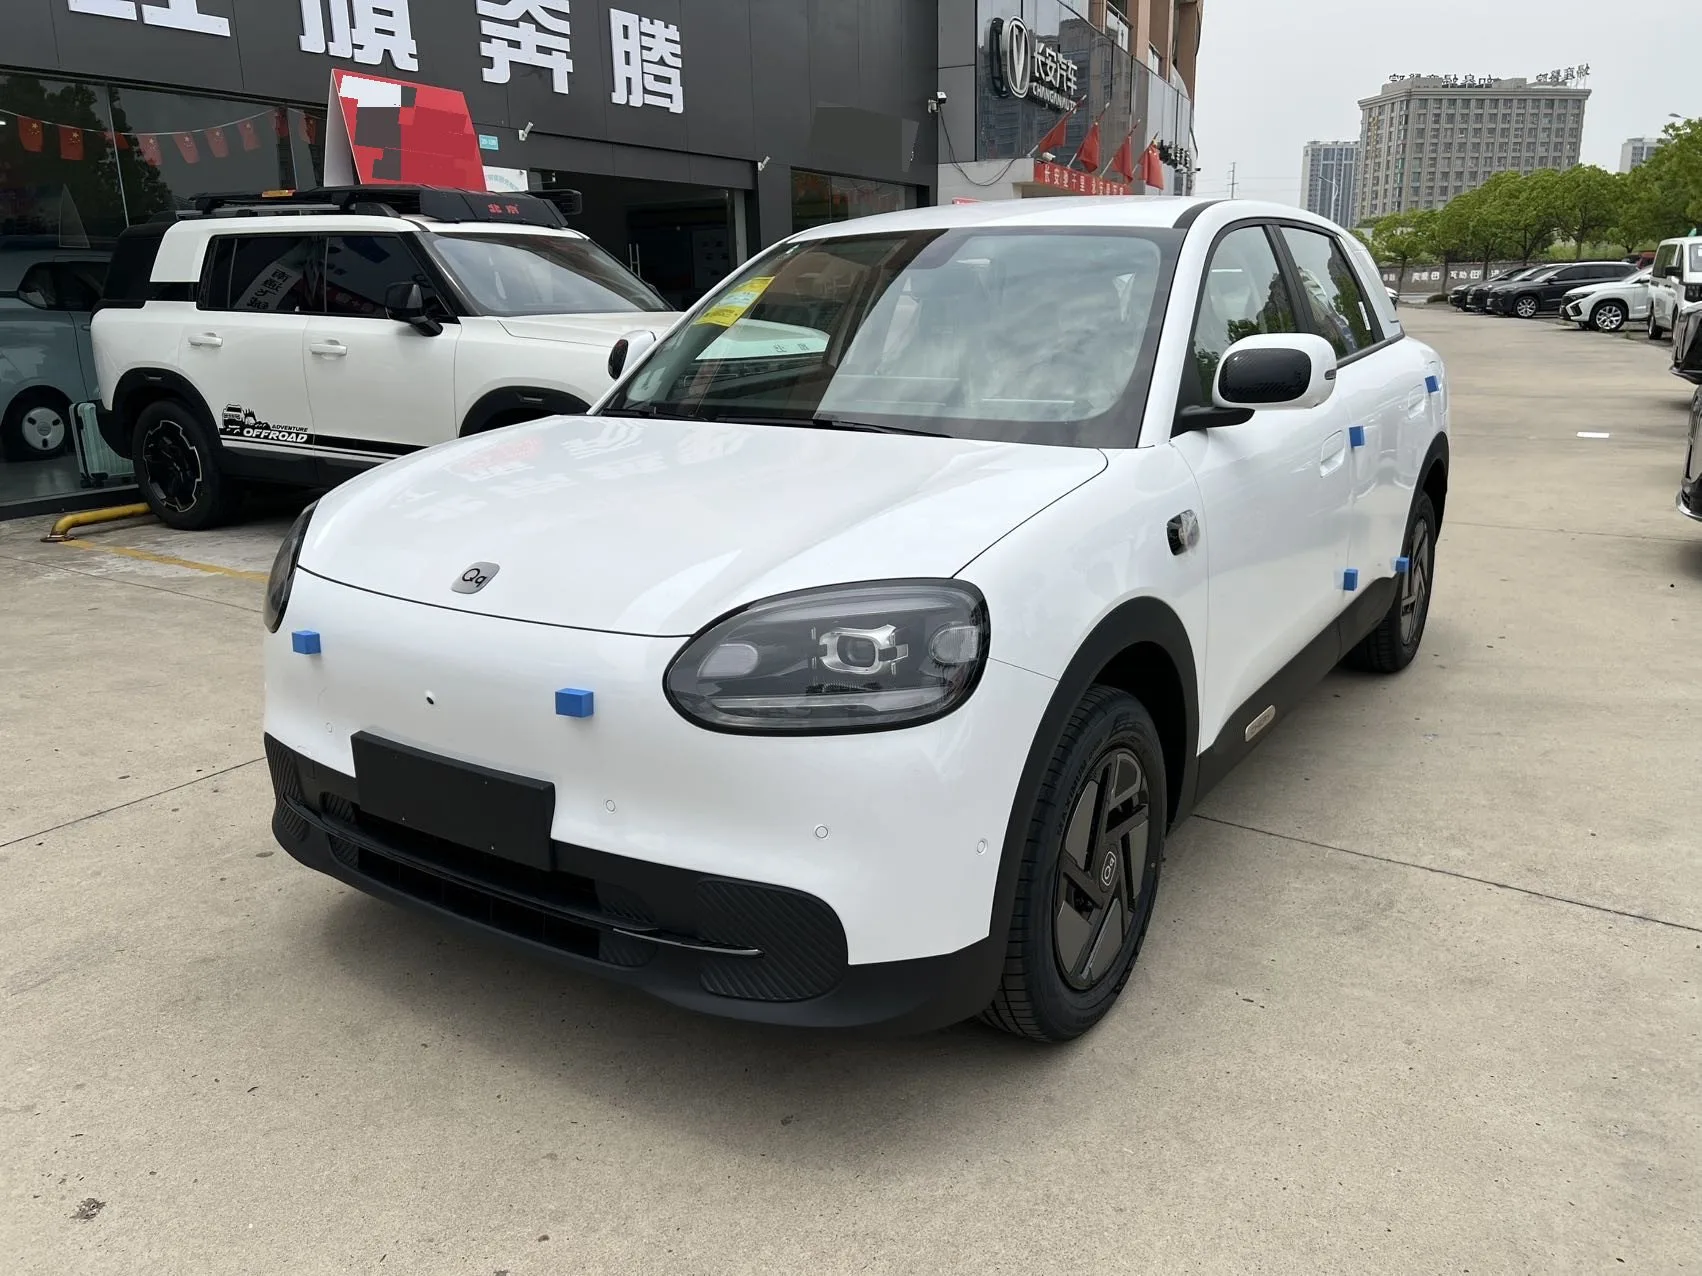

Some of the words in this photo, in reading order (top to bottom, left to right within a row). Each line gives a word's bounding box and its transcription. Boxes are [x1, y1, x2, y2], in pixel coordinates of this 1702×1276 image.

[1033, 39, 1078, 95] 长安汽车
[243, 428, 308, 443] OFFROAD
[271, 424, 309, 433] ADVENTURE
